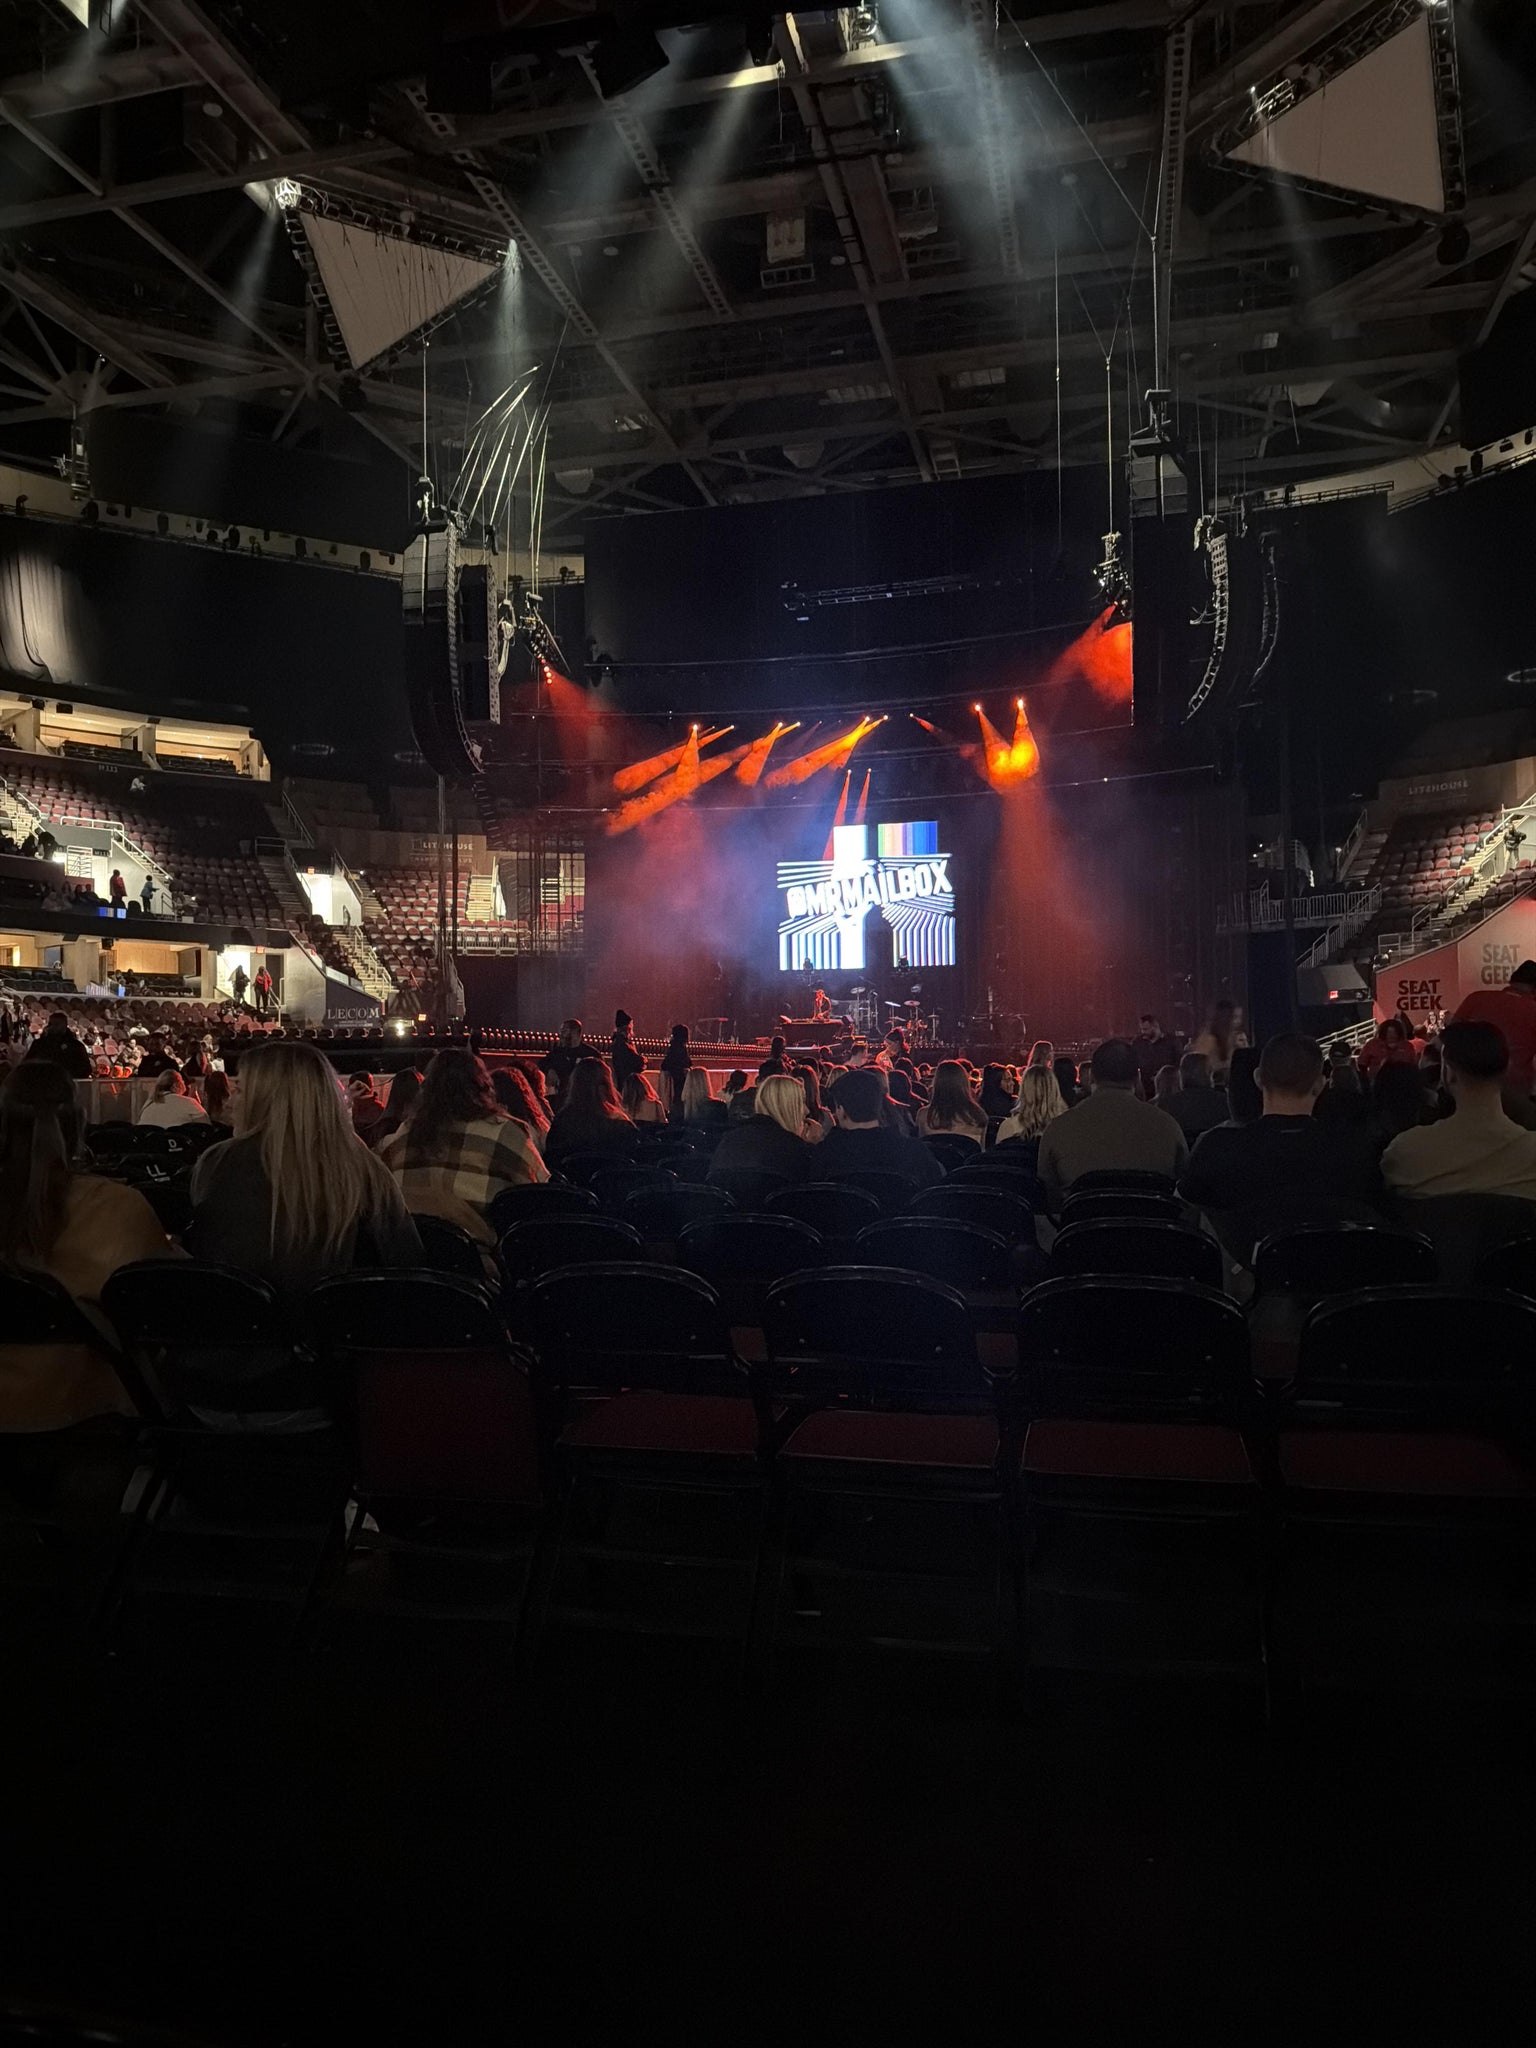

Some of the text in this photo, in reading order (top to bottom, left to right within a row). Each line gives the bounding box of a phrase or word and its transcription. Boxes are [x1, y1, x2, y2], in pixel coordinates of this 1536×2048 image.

[423, 841, 473, 851] LITHUSE
[1481, 943, 1520, 963] SEAT
[1398, 979, 1441, 995] SEAT
[1396, 995, 1443, 1011] GEEK
[327, 1007, 380, 1020] LECOM
